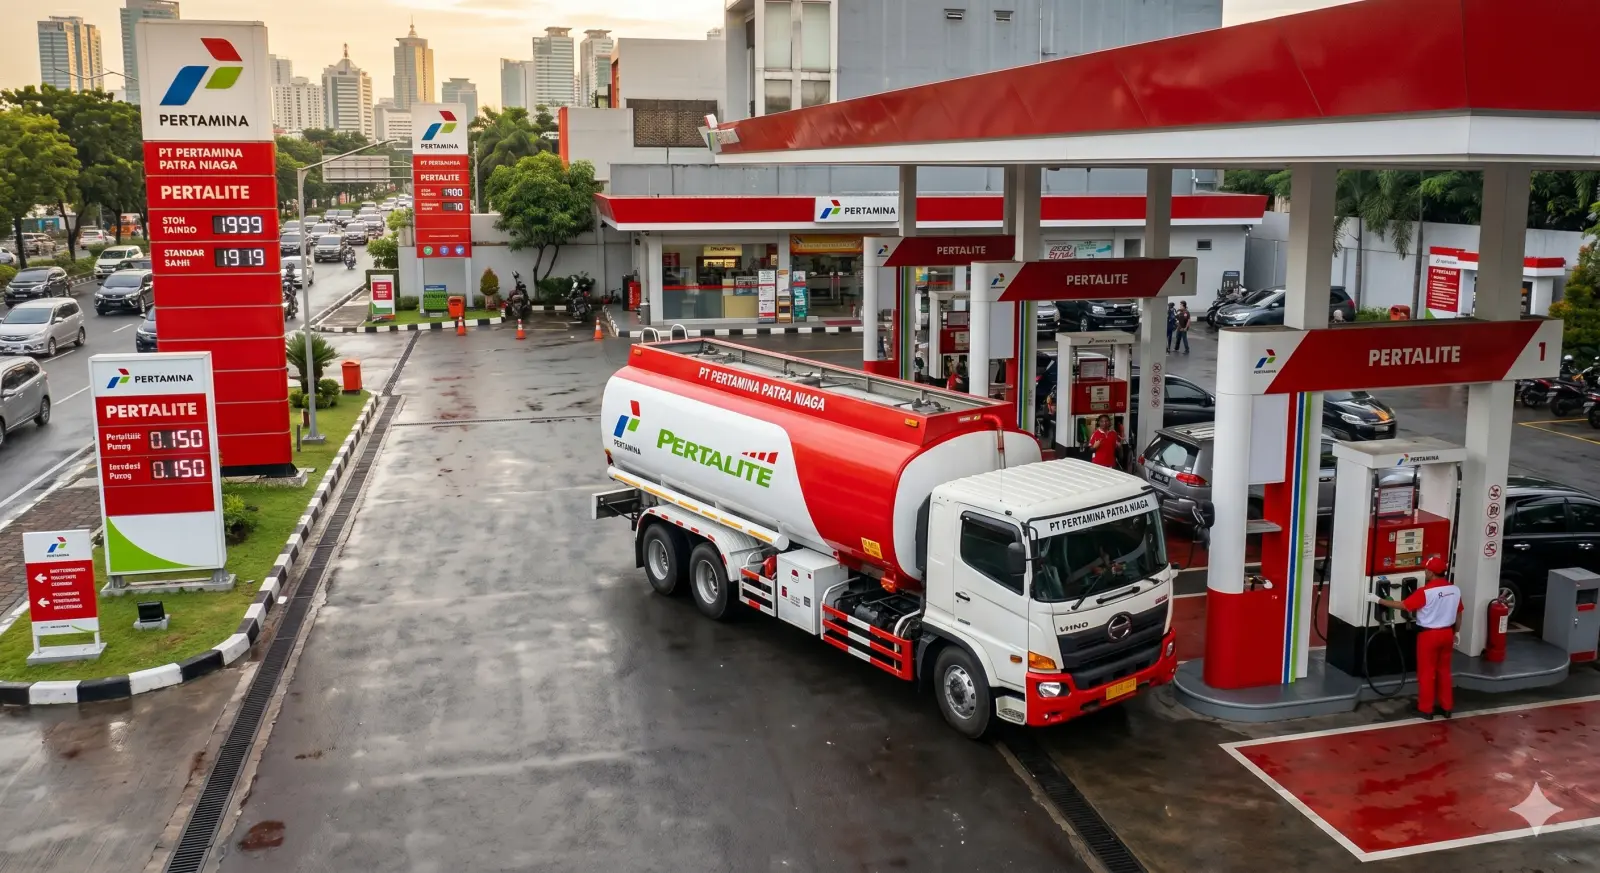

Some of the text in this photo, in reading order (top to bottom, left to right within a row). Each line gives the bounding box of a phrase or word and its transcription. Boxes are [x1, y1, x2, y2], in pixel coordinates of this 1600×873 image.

[159, 114, 249, 127] PERTAMINA
[159, 148, 243, 158] PT PERTAMINA
[160, 160, 238, 170] PATRA NIAGA
[421, 174, 460, 182] PERTALITE
[161, 185, 250, 200] PERTALITE
[844, 207, 896, 215] PERTAMINA
[162, 216, 262, 234] STOH 1999
[164, 249, 205, 257] STANDAR
[936, 246, 986, 255] PERTALITE
[1066, 273, 1129, 286] PERTALITE
[1179, 271, 1186, 285] 1
[1368, 346, 1461, 367] PERTALITE
[1538, 342, 1547, 362] 1
[134, 374, 194, 383] PERTAMINA
[698, 366, 825, 411] PT PERTAMINA PATRA NIAGA
[105, 402, 198, 419] PERTALITE
[150, 429, 203, 449] 0.150
[656, 428, 774, 489] PERTALITE
[153, 459, 205, 479] 0.150
[1049, 499, 1149, 531] PT PERTAMINA PATRA NIAGA
